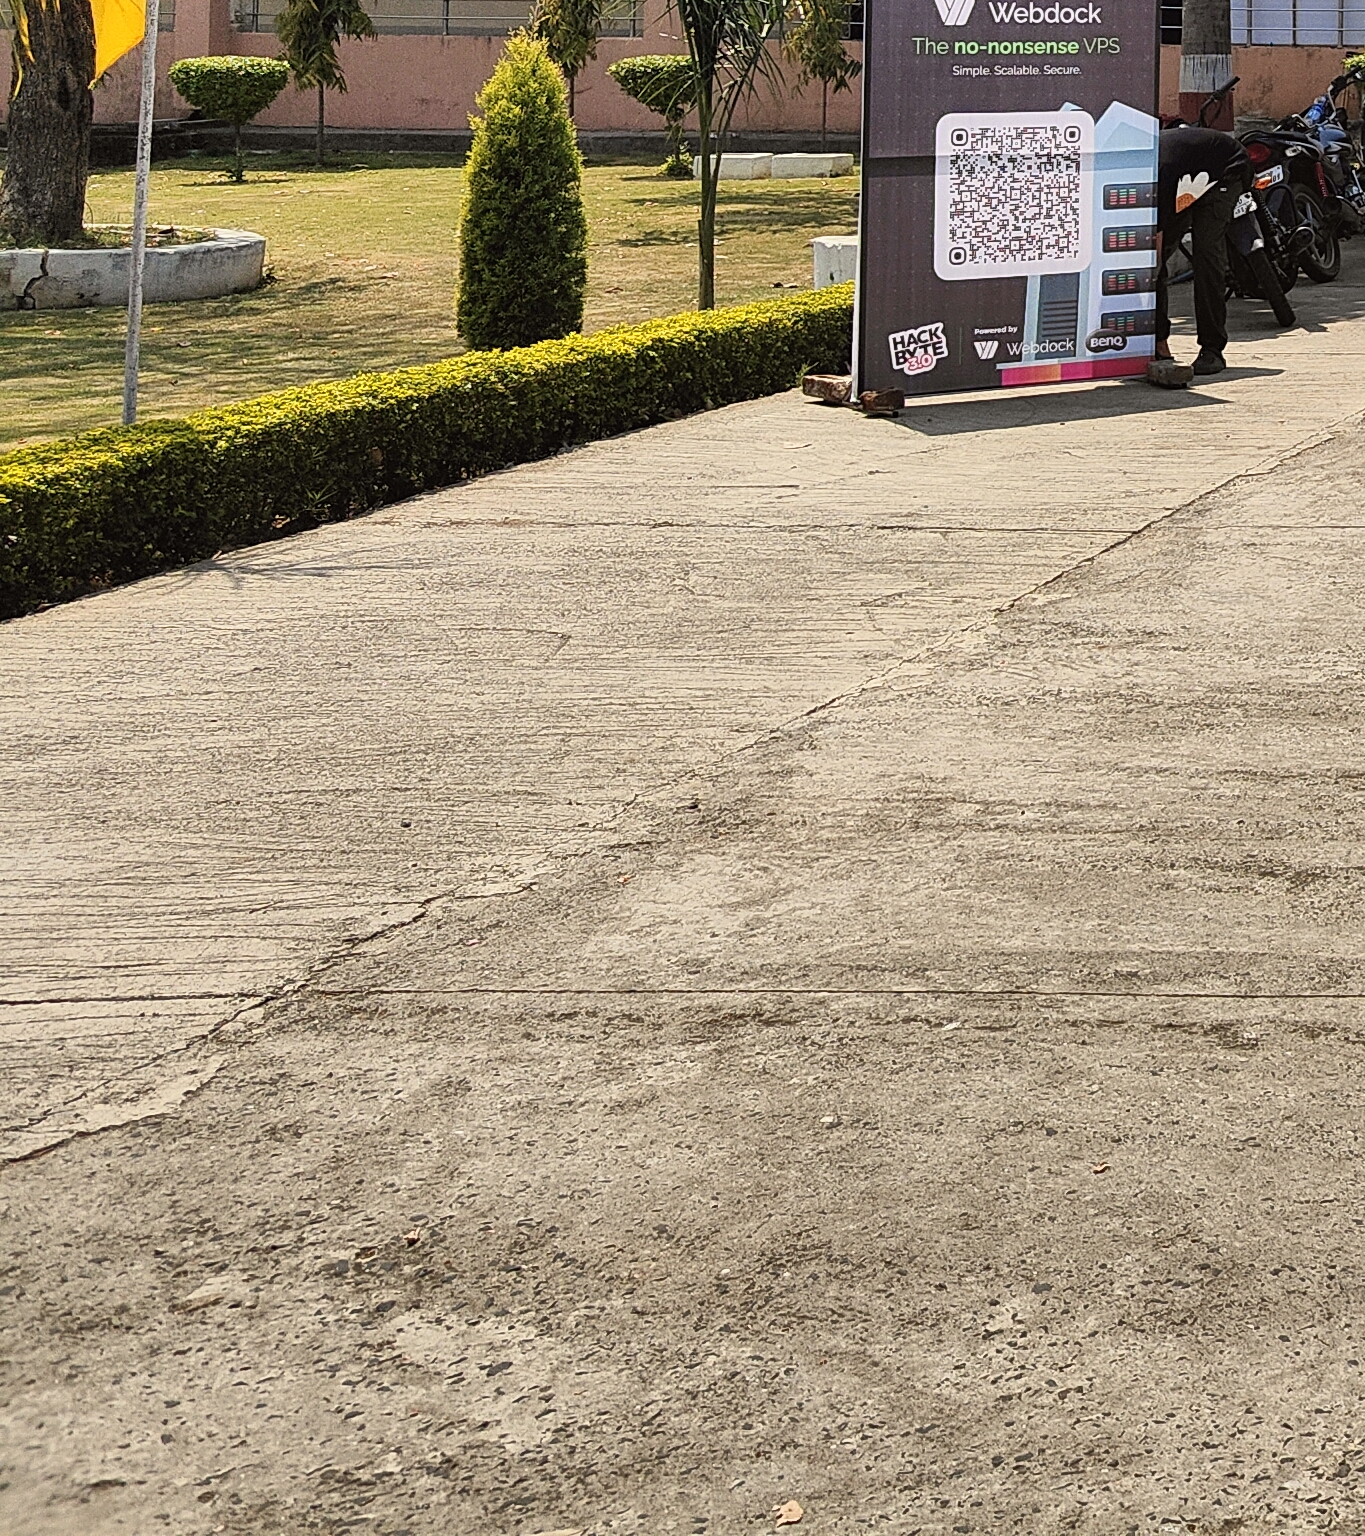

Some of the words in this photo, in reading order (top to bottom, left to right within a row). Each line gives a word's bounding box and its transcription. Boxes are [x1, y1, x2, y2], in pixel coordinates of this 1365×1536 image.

[988, 1, 1102, 24] Webdock
[912, 36, 950, 55] The
[954, 40, 1080, 55] no-nonsense
[1083, 37, 1121, 54] VPS
[952, 65, 993, 77] Simple.
[994, 64, 1042, 76] Scalable.
[1043, 64, 1083, 76] Secure.
[892, 327, 943, 351] HACK
[974, 325, 1007, 335] Powered
[1008, 325, 1018, 335] by
[1006, 338, 1075, 356] Webdock
[1090, 335, 1124, 348] BenQ
[895, 342, 946, 366] BYTE
[907, 353, 933, 371] 3.0
